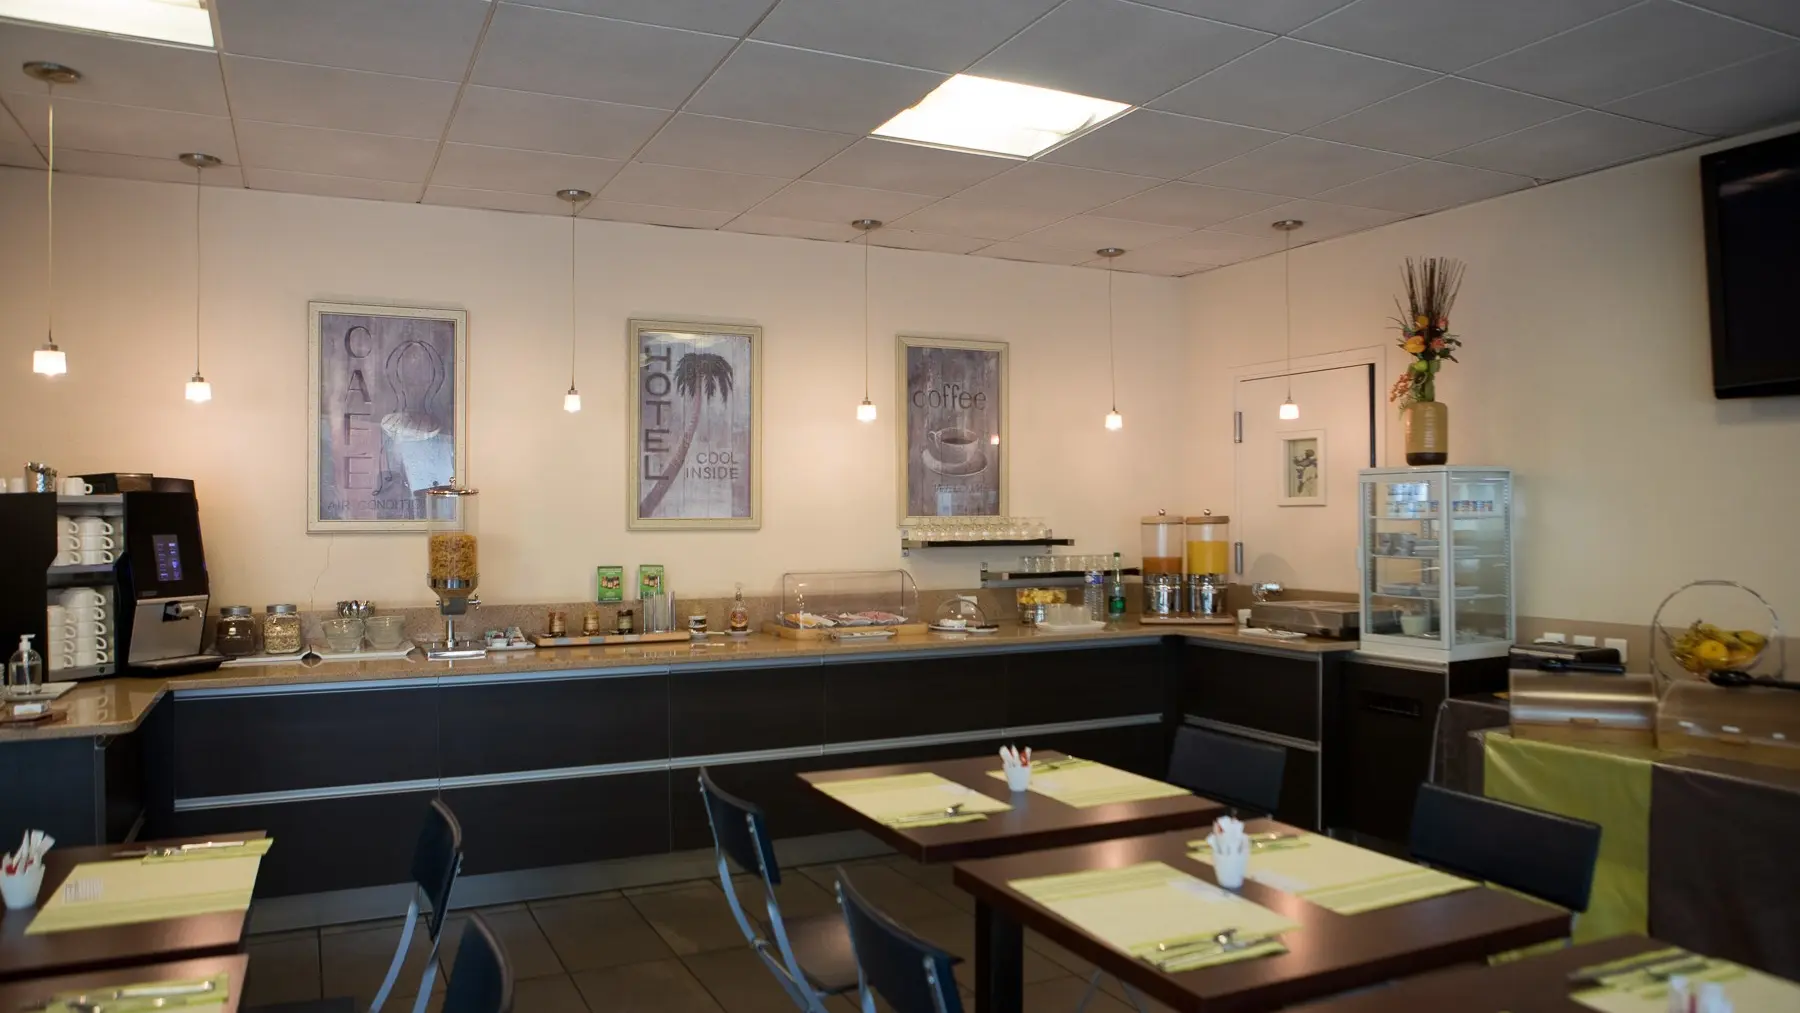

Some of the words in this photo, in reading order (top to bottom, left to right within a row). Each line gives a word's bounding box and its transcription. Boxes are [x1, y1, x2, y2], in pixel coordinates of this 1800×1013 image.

[912, 383, 987, 411] coffee
[643, 346, 672, 481] HOTEL
[696, 451, 740, 465] COOL
[686, 467, 740, 481] INSIDE
[327, 500, 351, 511] AIR
